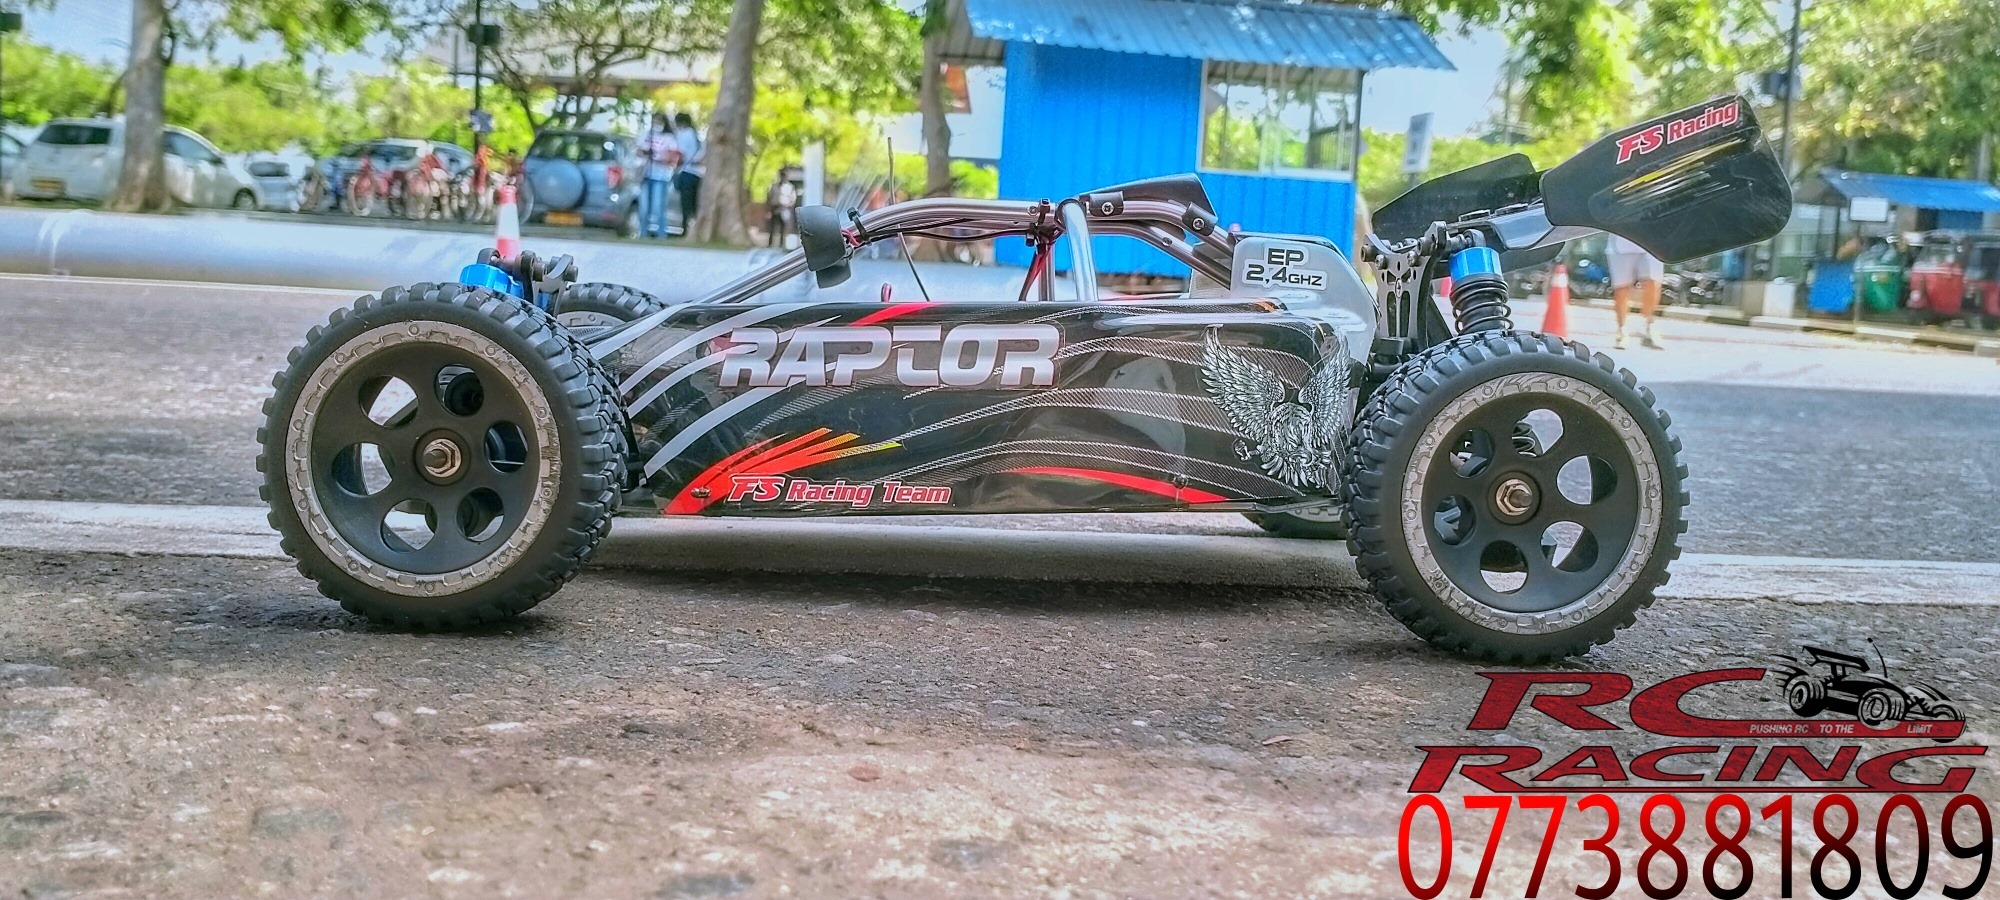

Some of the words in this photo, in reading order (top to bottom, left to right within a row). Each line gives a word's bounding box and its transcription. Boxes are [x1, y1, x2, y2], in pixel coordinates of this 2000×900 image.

[1616, 124, 1664, 165] FS
[1667, 102, 1739, 144] Racing
[1267, 247, 1304, 266] EP
[719, 324, 1061, 389] RAPTOR
[728, 476, 785, 502] FS
[786, 480, 874, 507] Racing
[883, 481, 951, 503] Team
